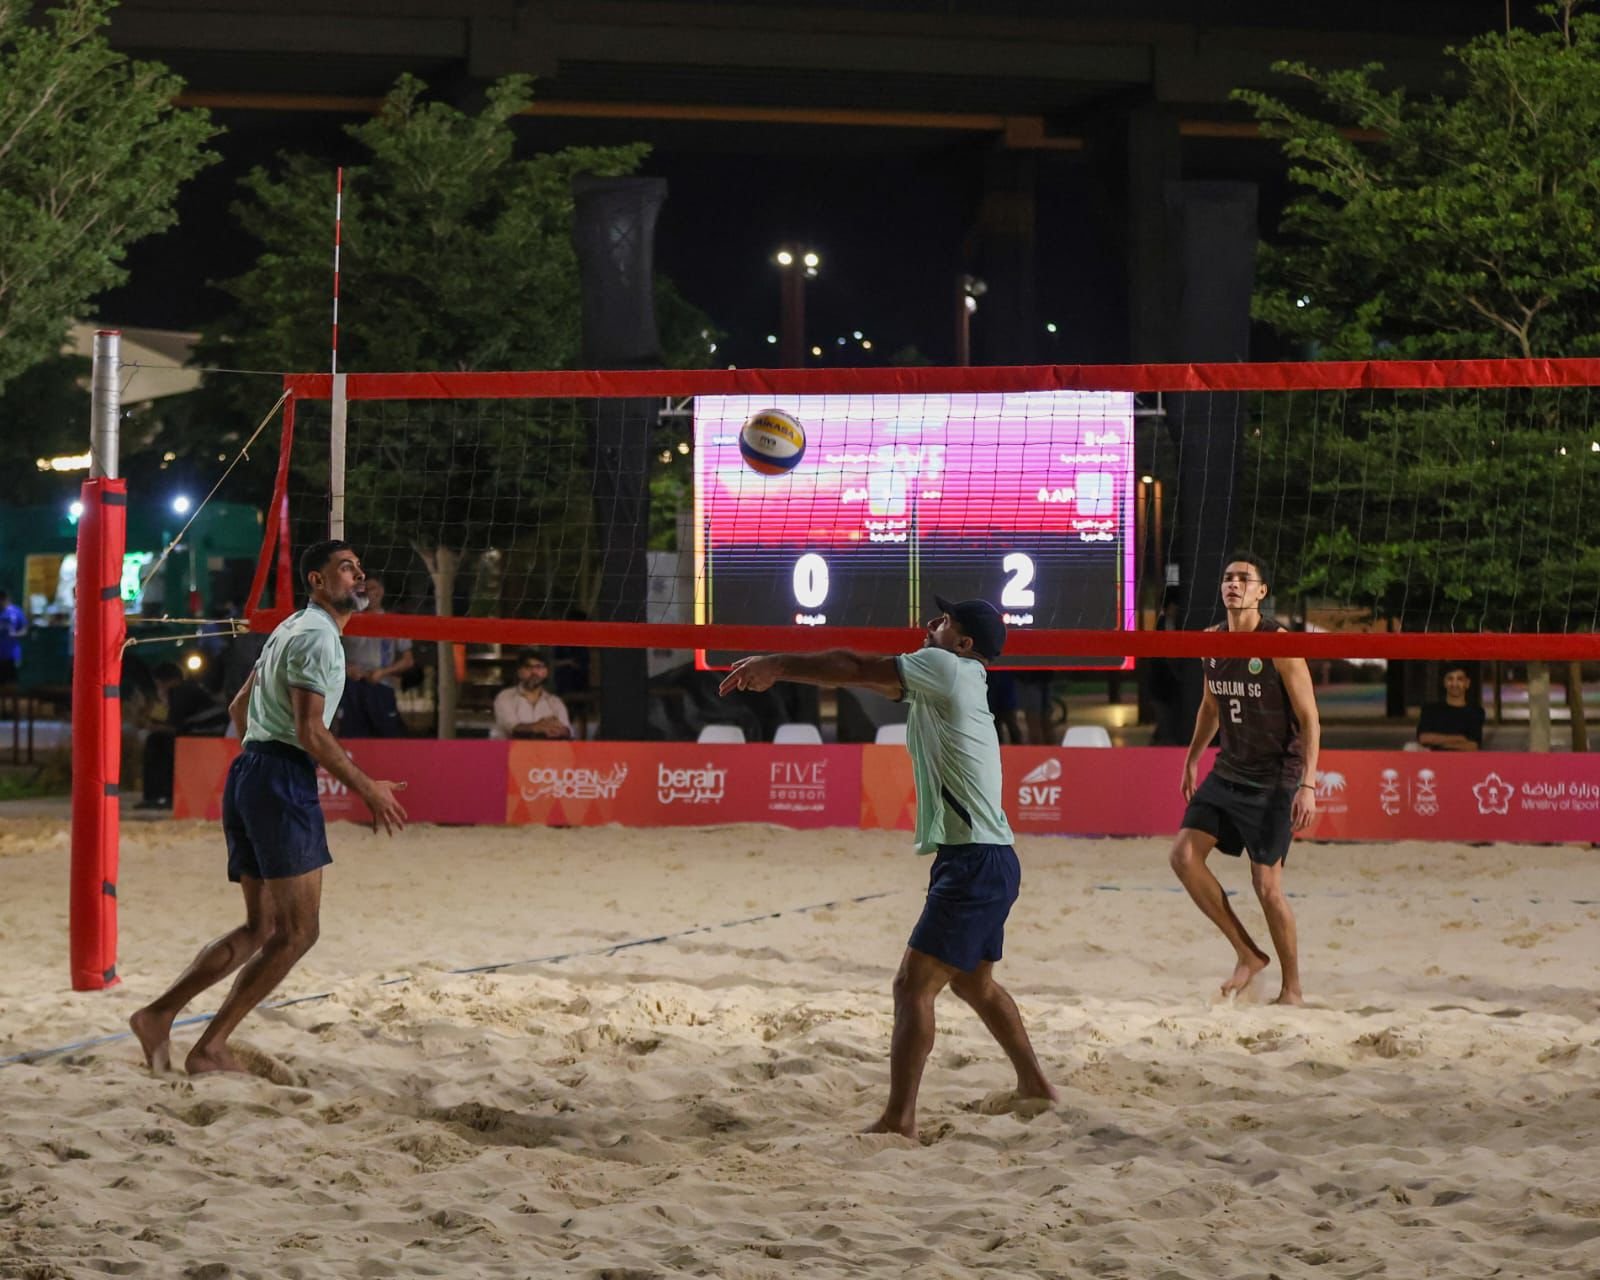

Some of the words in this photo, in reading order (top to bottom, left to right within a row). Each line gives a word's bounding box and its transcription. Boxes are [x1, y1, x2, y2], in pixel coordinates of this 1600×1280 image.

[793, 553, 829, 608] 0
[1001, 552, 1035, 607] 2
[1247, 683, 1262, 698] SC
[1229, 698, 1242, 723] 2
[528, 767, 599, 784] GOLDEN
[658, 762, 724, 788] berain
[771, 761, 825, 784] FIVE
[551, 782, 620, 799] SCENT
[1019, 786, 1062, 805] SVF
